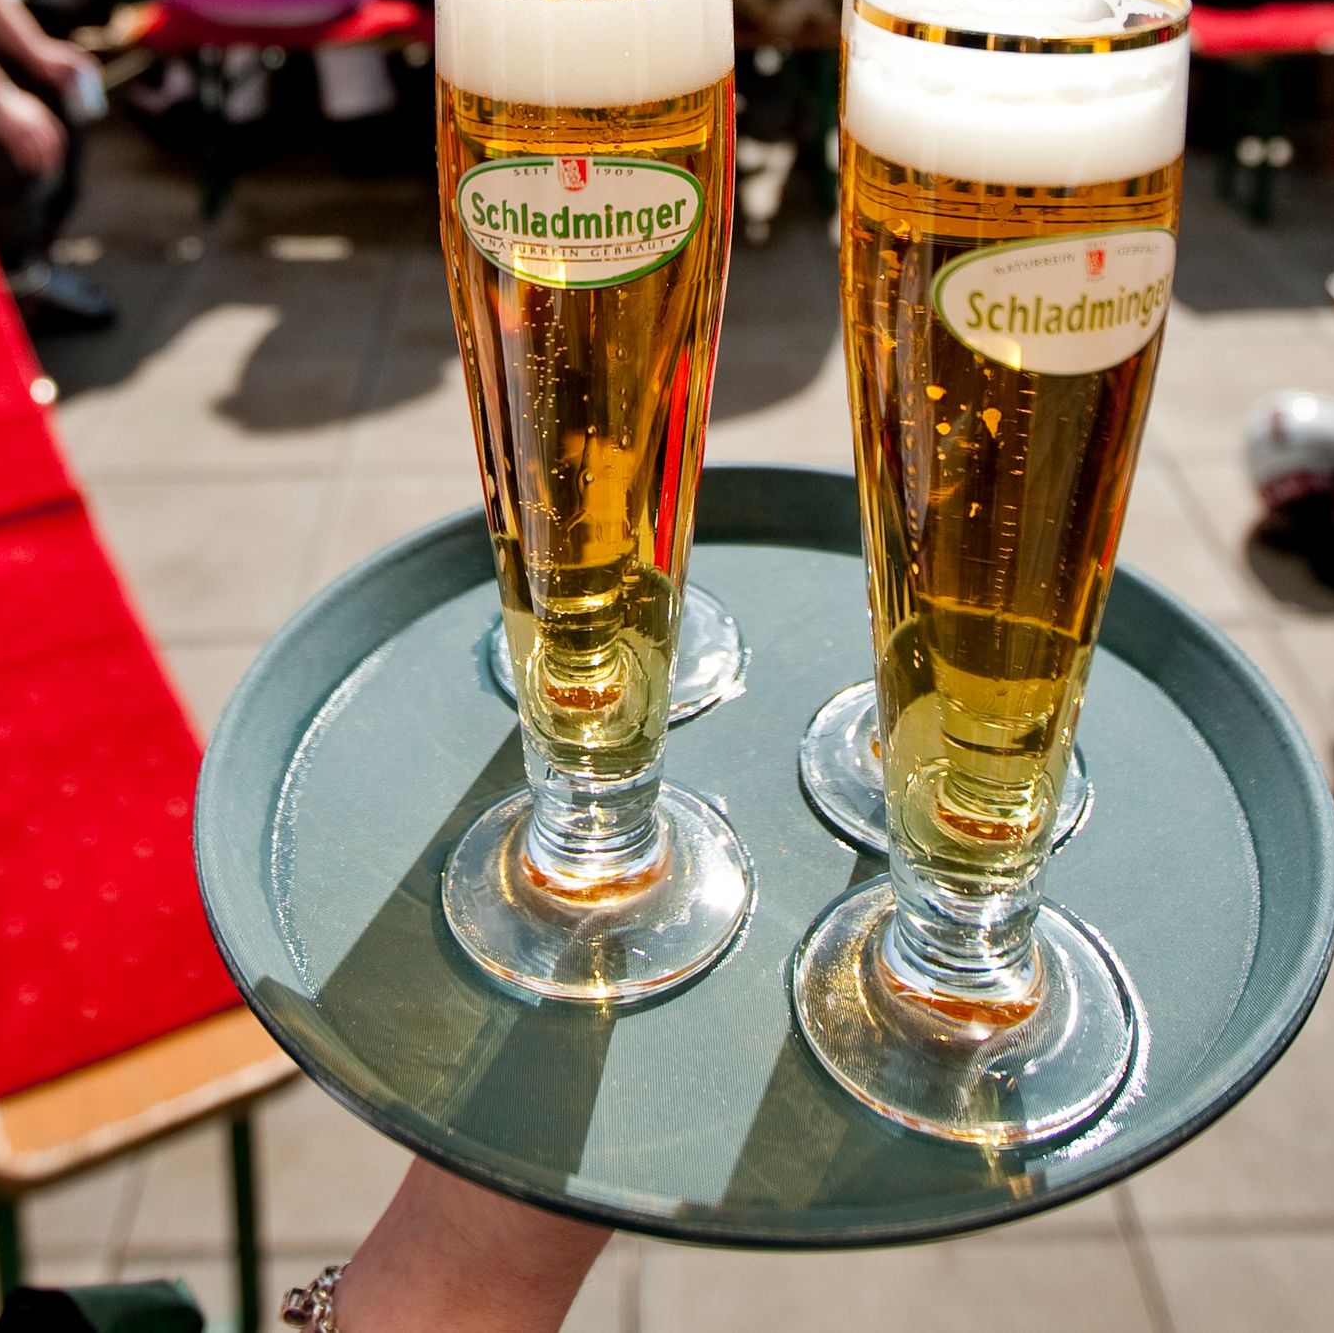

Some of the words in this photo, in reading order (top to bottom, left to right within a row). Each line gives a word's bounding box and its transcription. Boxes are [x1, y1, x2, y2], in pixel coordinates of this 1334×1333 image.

[513, 167, 549, 177] SEIT
[595, 167, 634, 177] 1909
[470, 191, 687, 240] Schladminger
[590, 239, 666, 257] GEBRAUT
